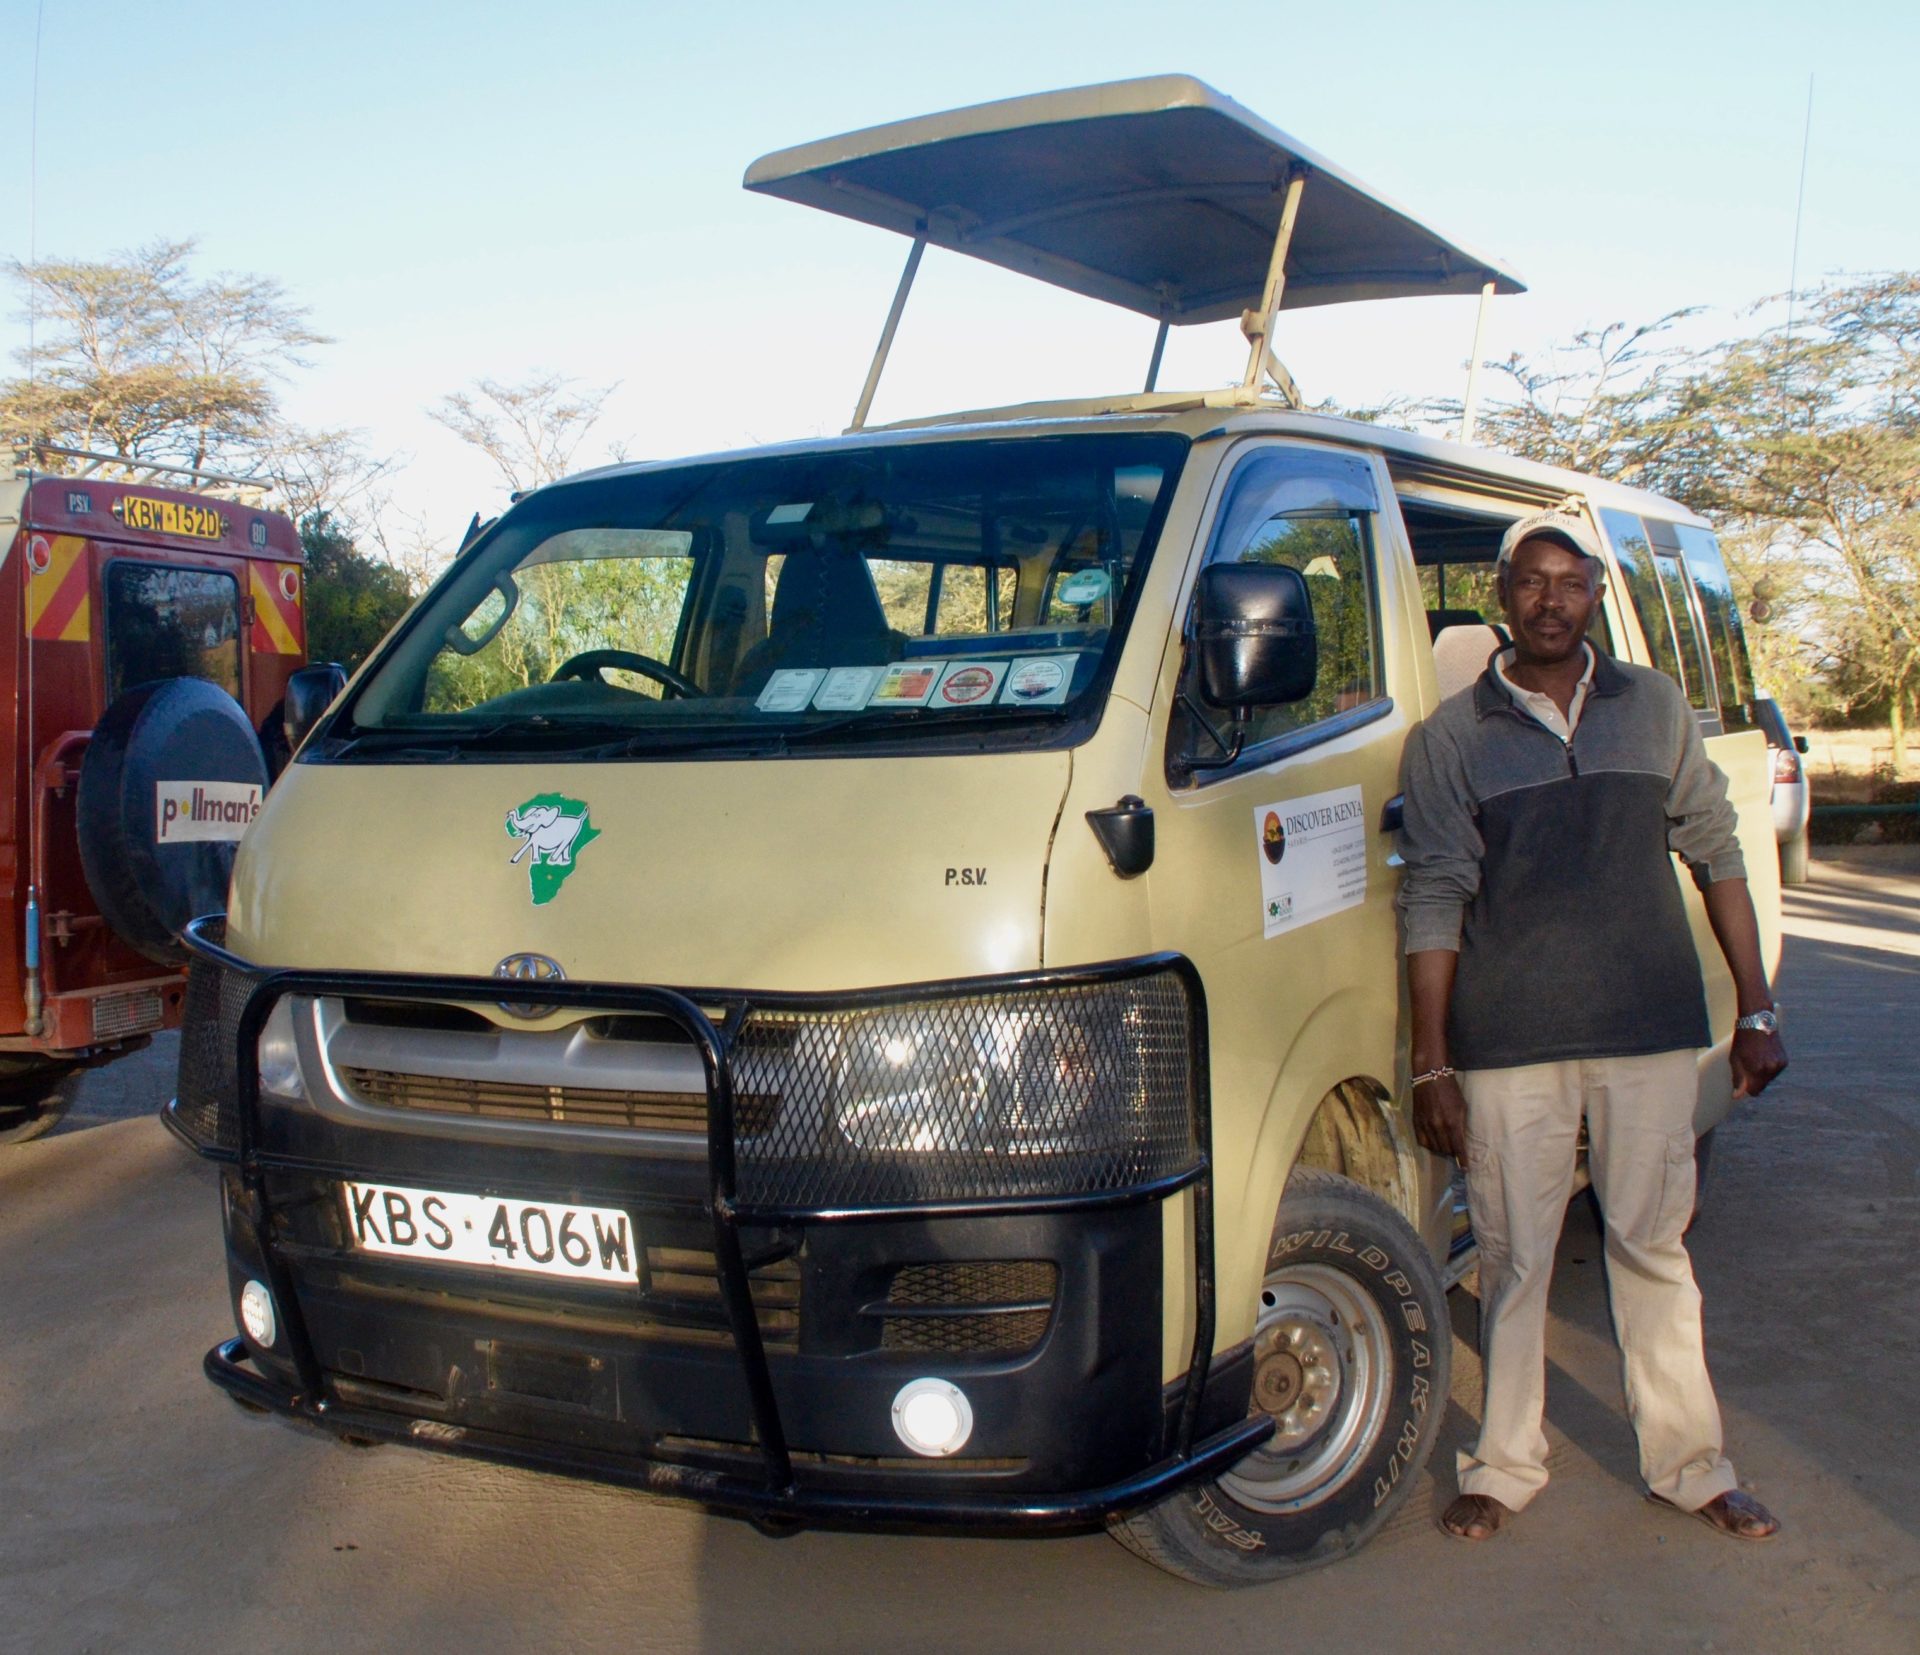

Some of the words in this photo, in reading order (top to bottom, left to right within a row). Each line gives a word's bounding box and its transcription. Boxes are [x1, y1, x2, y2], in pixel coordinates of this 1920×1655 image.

[1286, 806, 1333, 835] DISCOVER
[1333, 800, 1364, 822] KENYA
[945, 867, 987, 886] P.S.V.
[1272, 1230, 1430, 1411] WILDPEAK
[1196, 1487, 1266, 1550] FAL
